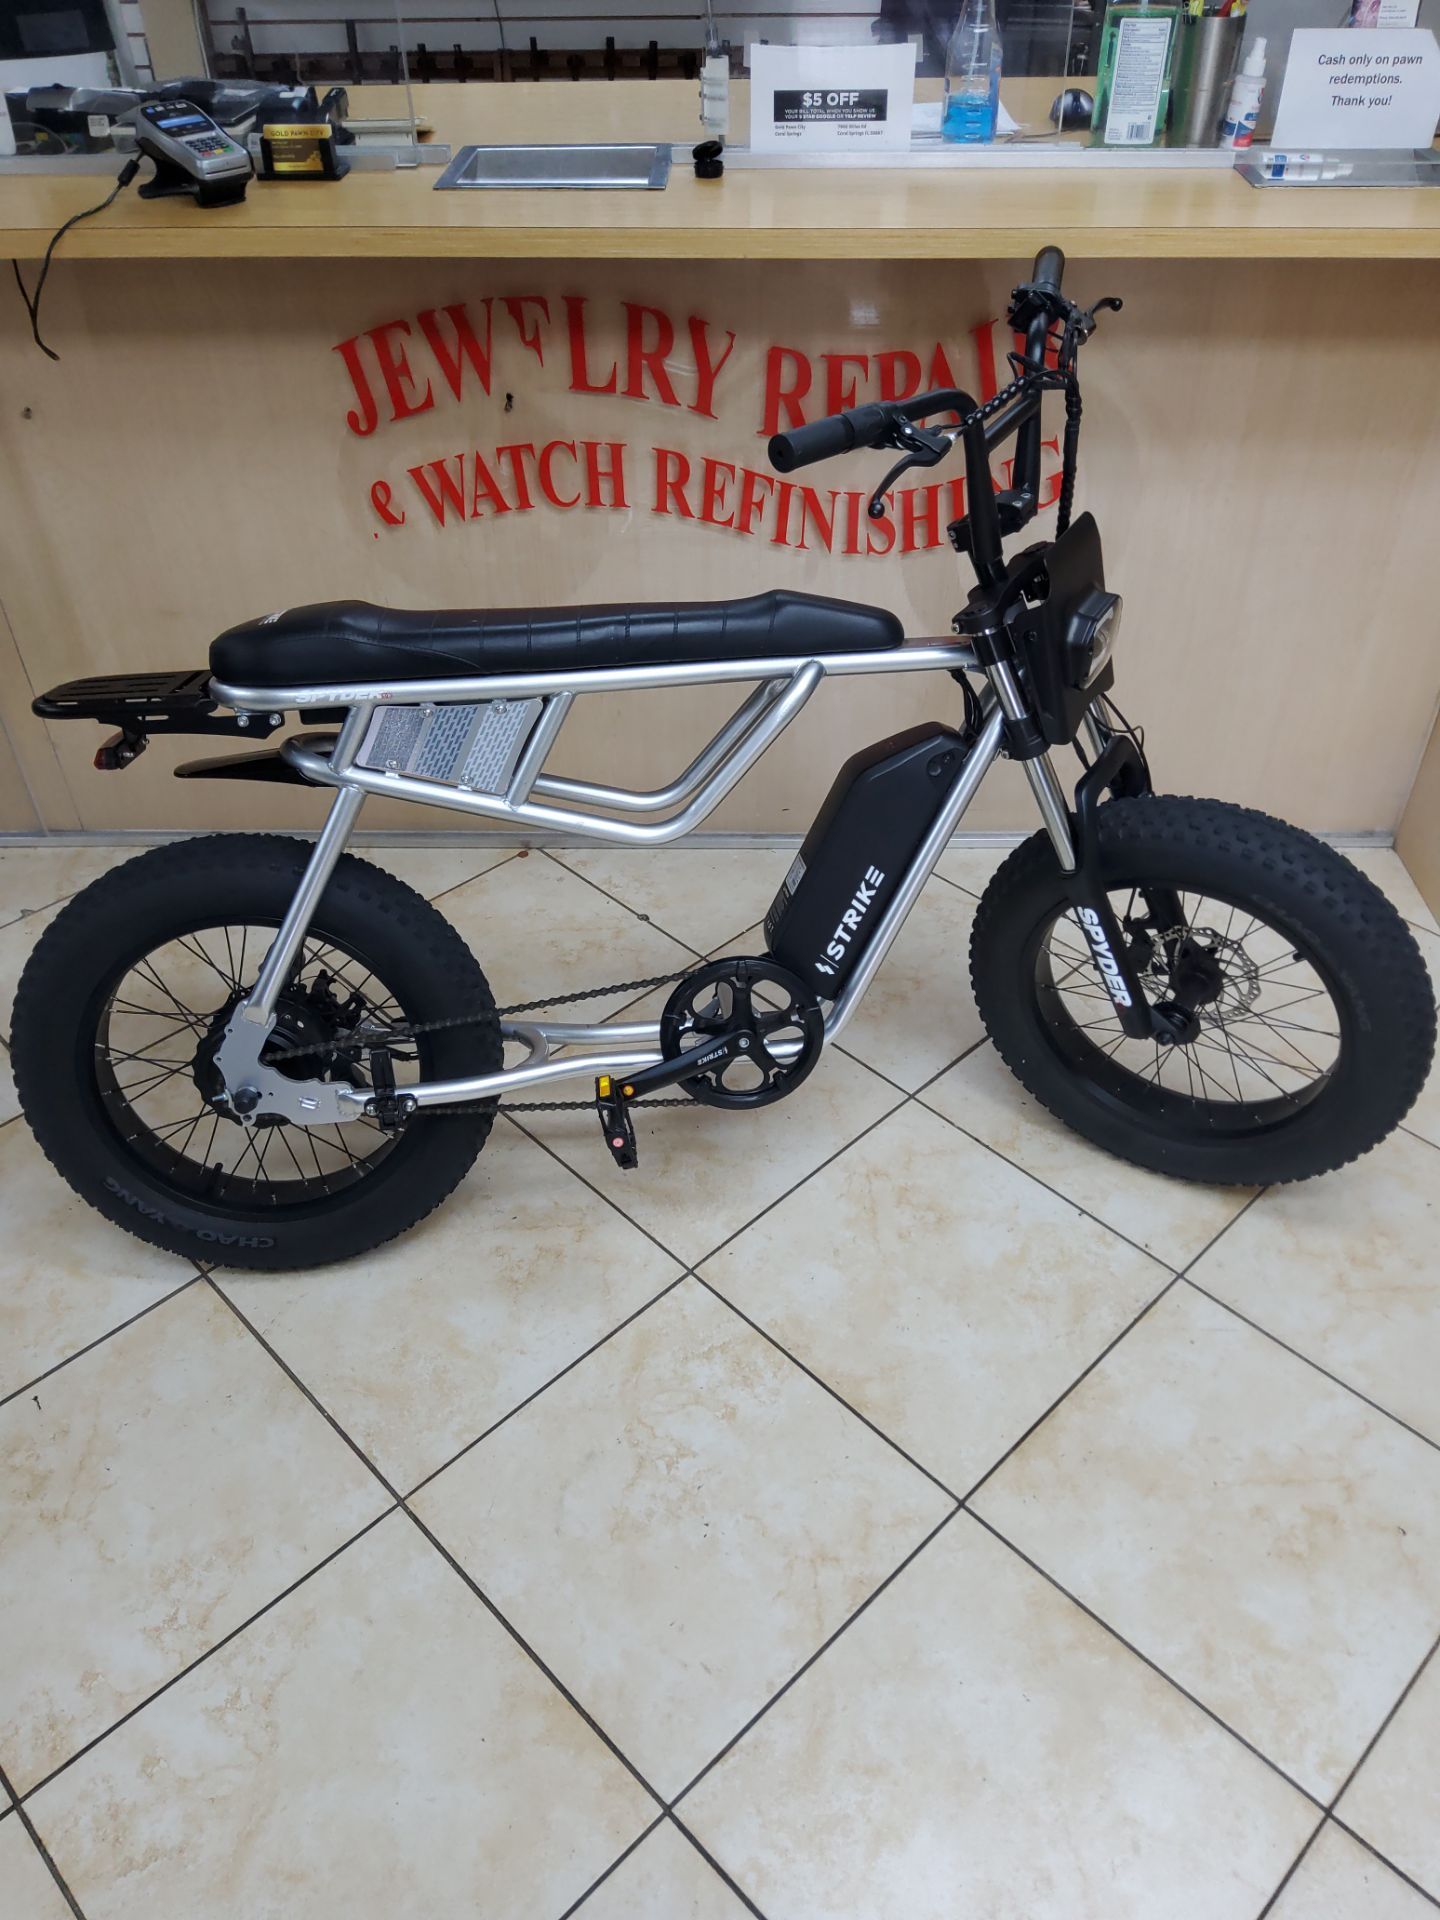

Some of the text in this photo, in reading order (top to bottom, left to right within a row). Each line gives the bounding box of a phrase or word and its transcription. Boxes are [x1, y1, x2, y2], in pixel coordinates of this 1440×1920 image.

[1318, 54, 1423, 67] Cash only on pawn
[1329, 73, 1403, 86] redemptions.
[802, 92, 859, 108] $5 OFF
[1331, 95, 1393, 108] Thank you!
[370, 480, 405, 539] &
[406, 439, 631, 528] WATCH
[826, 865, 885, 961] STRIKE
[1077, 906, 1132, 1008] SPYDER
[697, 1049, 723, 1066] STRIKE
[196, 1229, 275, 1248] CHAO
